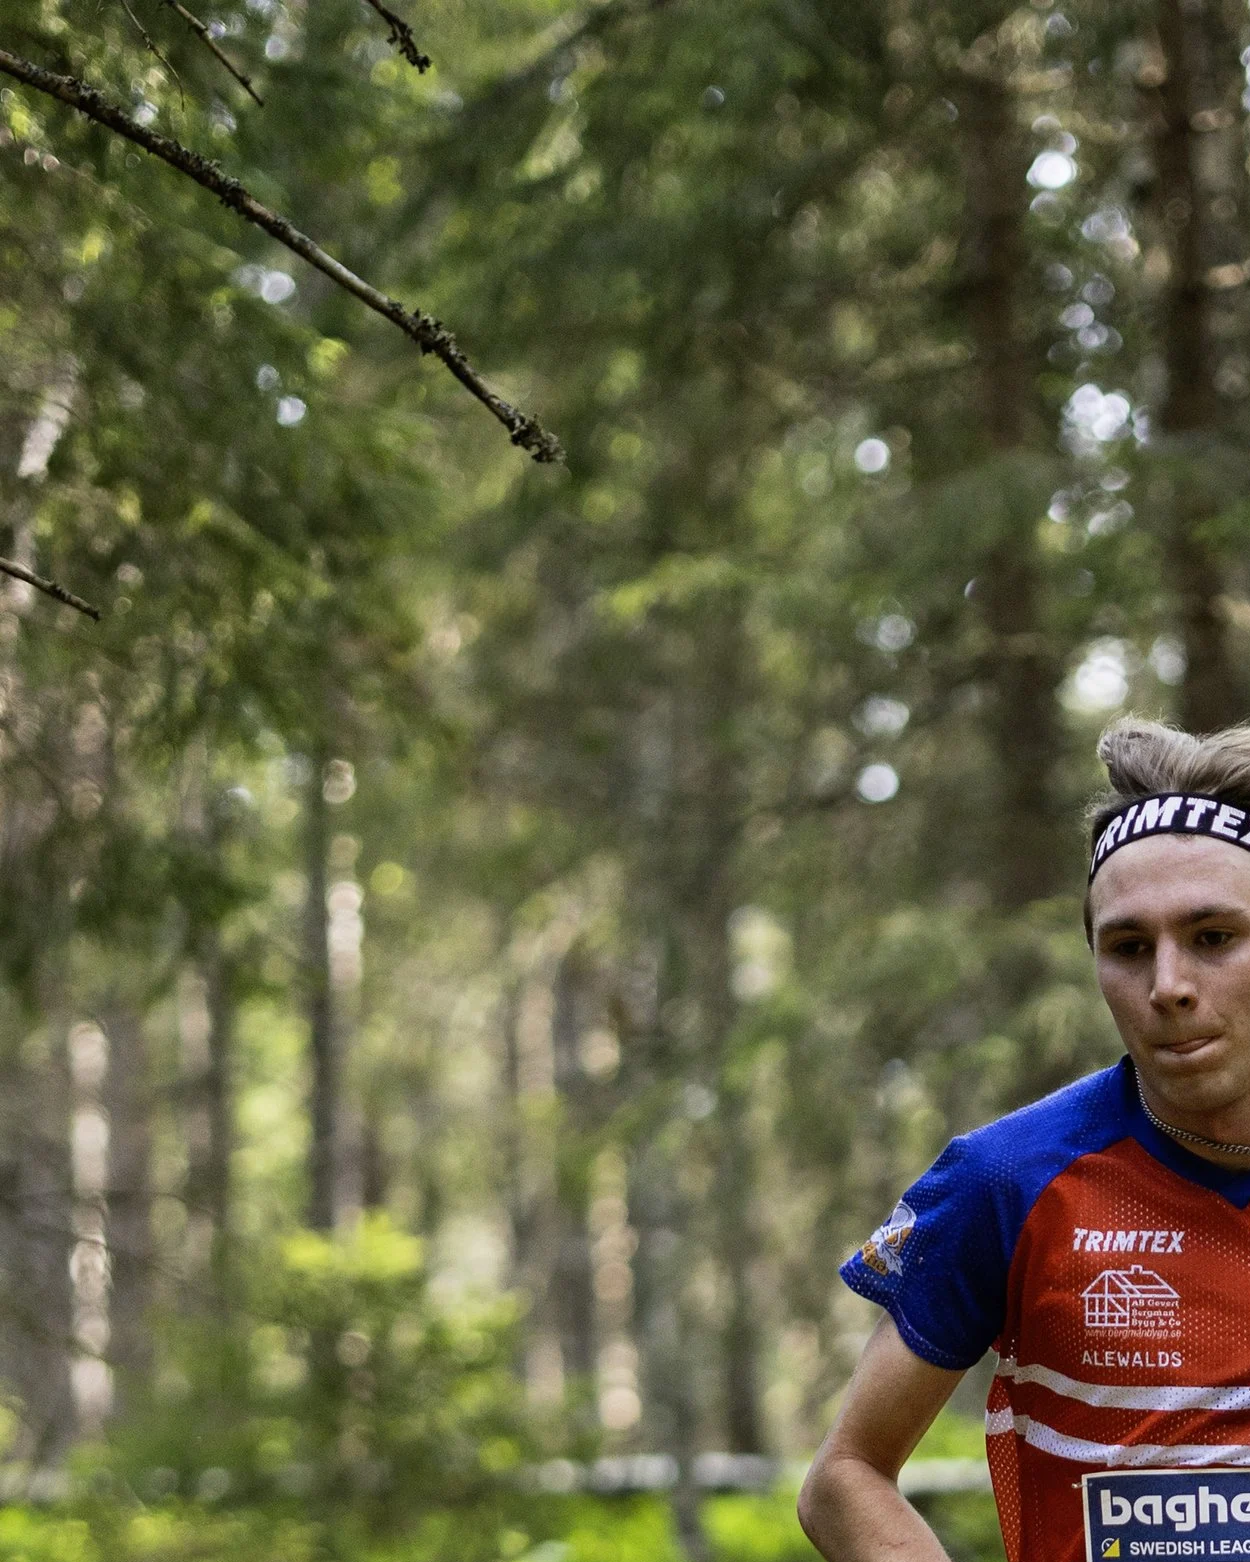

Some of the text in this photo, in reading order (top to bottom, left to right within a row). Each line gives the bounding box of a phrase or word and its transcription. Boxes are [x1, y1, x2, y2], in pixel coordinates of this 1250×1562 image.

[1072, 1227, 1186, 1253] TRIMTEX
[1131, 1299, 1145, 1307] AB
[1131, 1308, 1175, 1318] Bergman
[1131, 1318, 1181, 1328] Bygg & Co
[1081, 1350, 1183, 1368] ALEWALDS
[1130, 1541, 1205, 1556] SWEDISH
